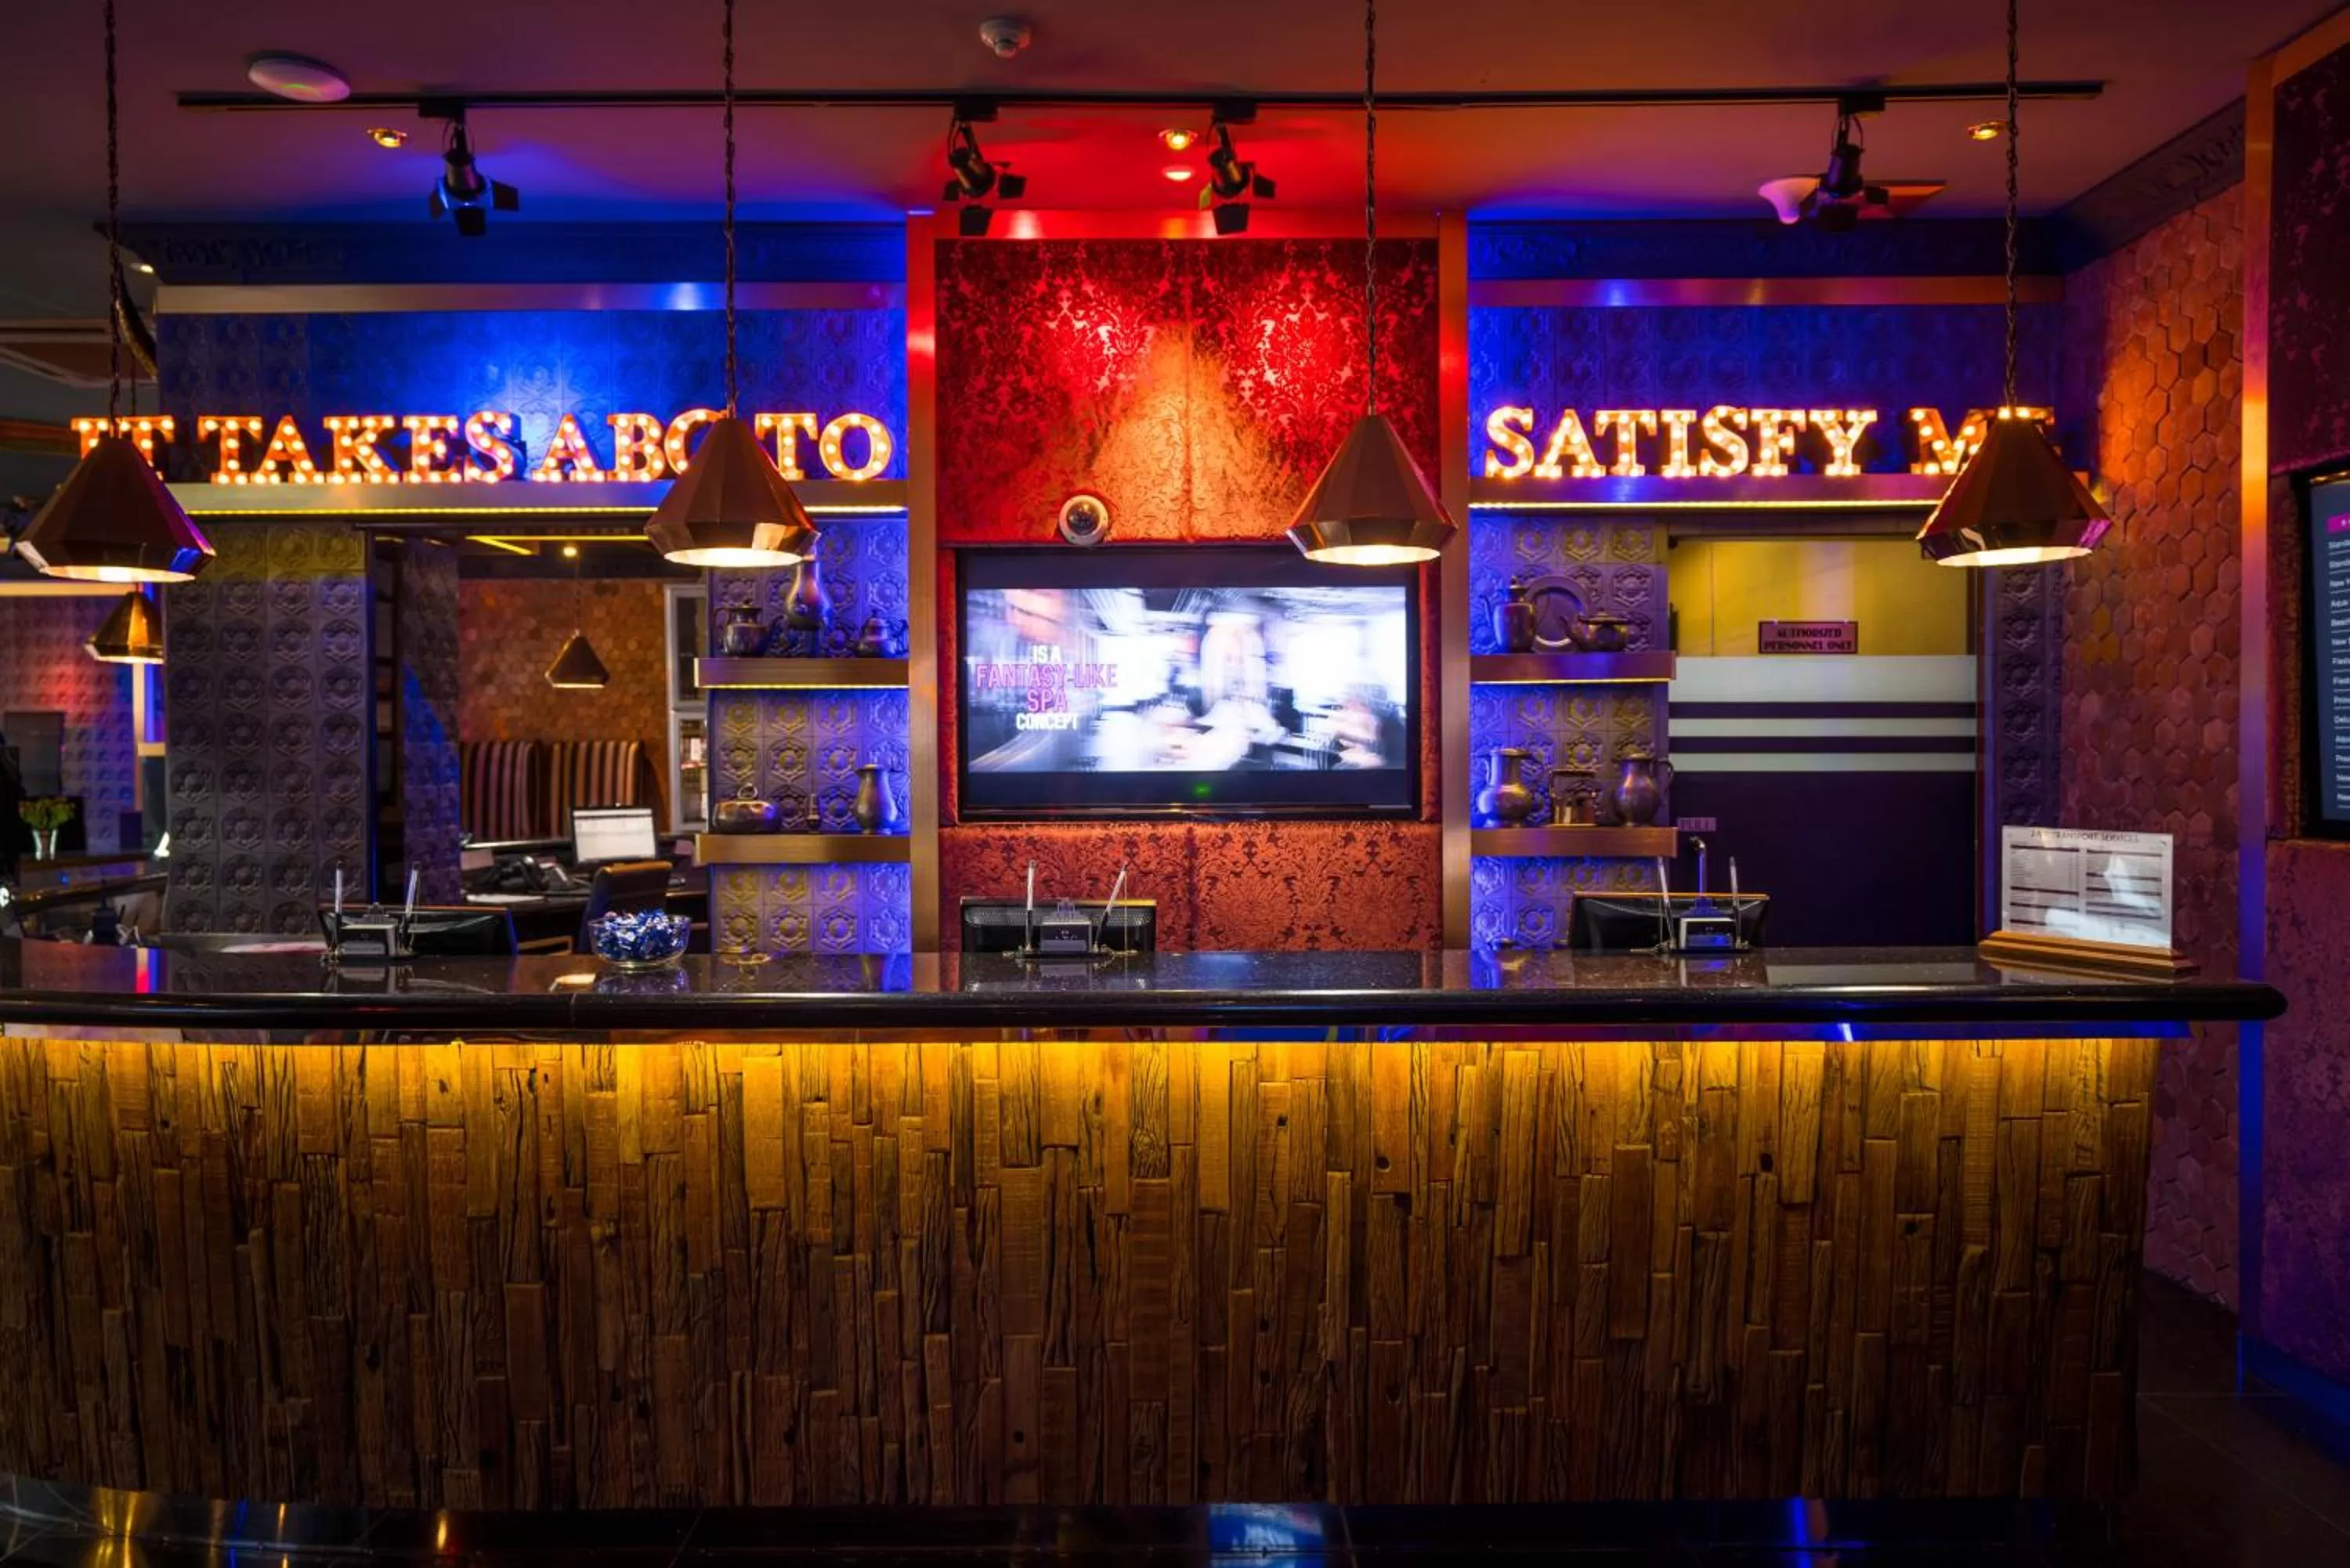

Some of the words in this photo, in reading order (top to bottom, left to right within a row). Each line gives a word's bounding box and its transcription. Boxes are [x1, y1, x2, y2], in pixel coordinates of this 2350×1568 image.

[197, 410, 515, 485] TAKES
[754, 412, 892, 482] TO
[1484, 404, 1878, 479] SATISFY
[1909, 407, 2061, 475] M
[1032, 645, 1047, 663] IS
[1050, 645, 1062, 663] A
[1764, 640, 1824, 651] PERSONNEL
[1827, 640, 1853, 651] ONLY
[976, 663, 1119, 689] FANTASY-LIKE
[1027, 688, 1068, 714] SPA
[1016, 712, 1079, 731] CONCEPT
